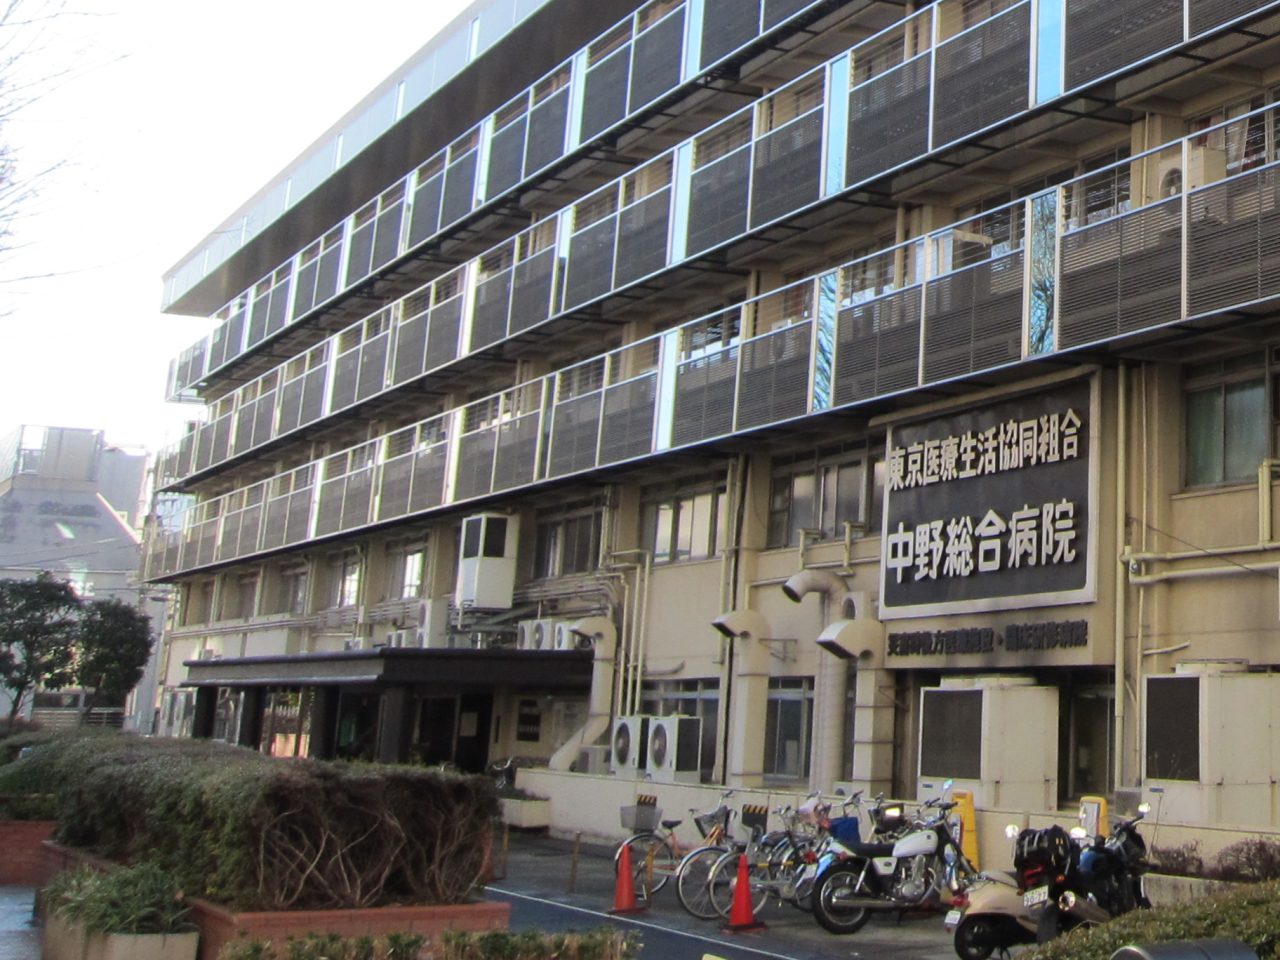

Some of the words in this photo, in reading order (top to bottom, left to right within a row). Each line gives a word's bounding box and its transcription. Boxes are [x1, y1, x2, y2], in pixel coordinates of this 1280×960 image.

[888, 407, 1081, 491] 東京医療生活協同組合
[886, 498, 1076, 584] 中野総合病院
